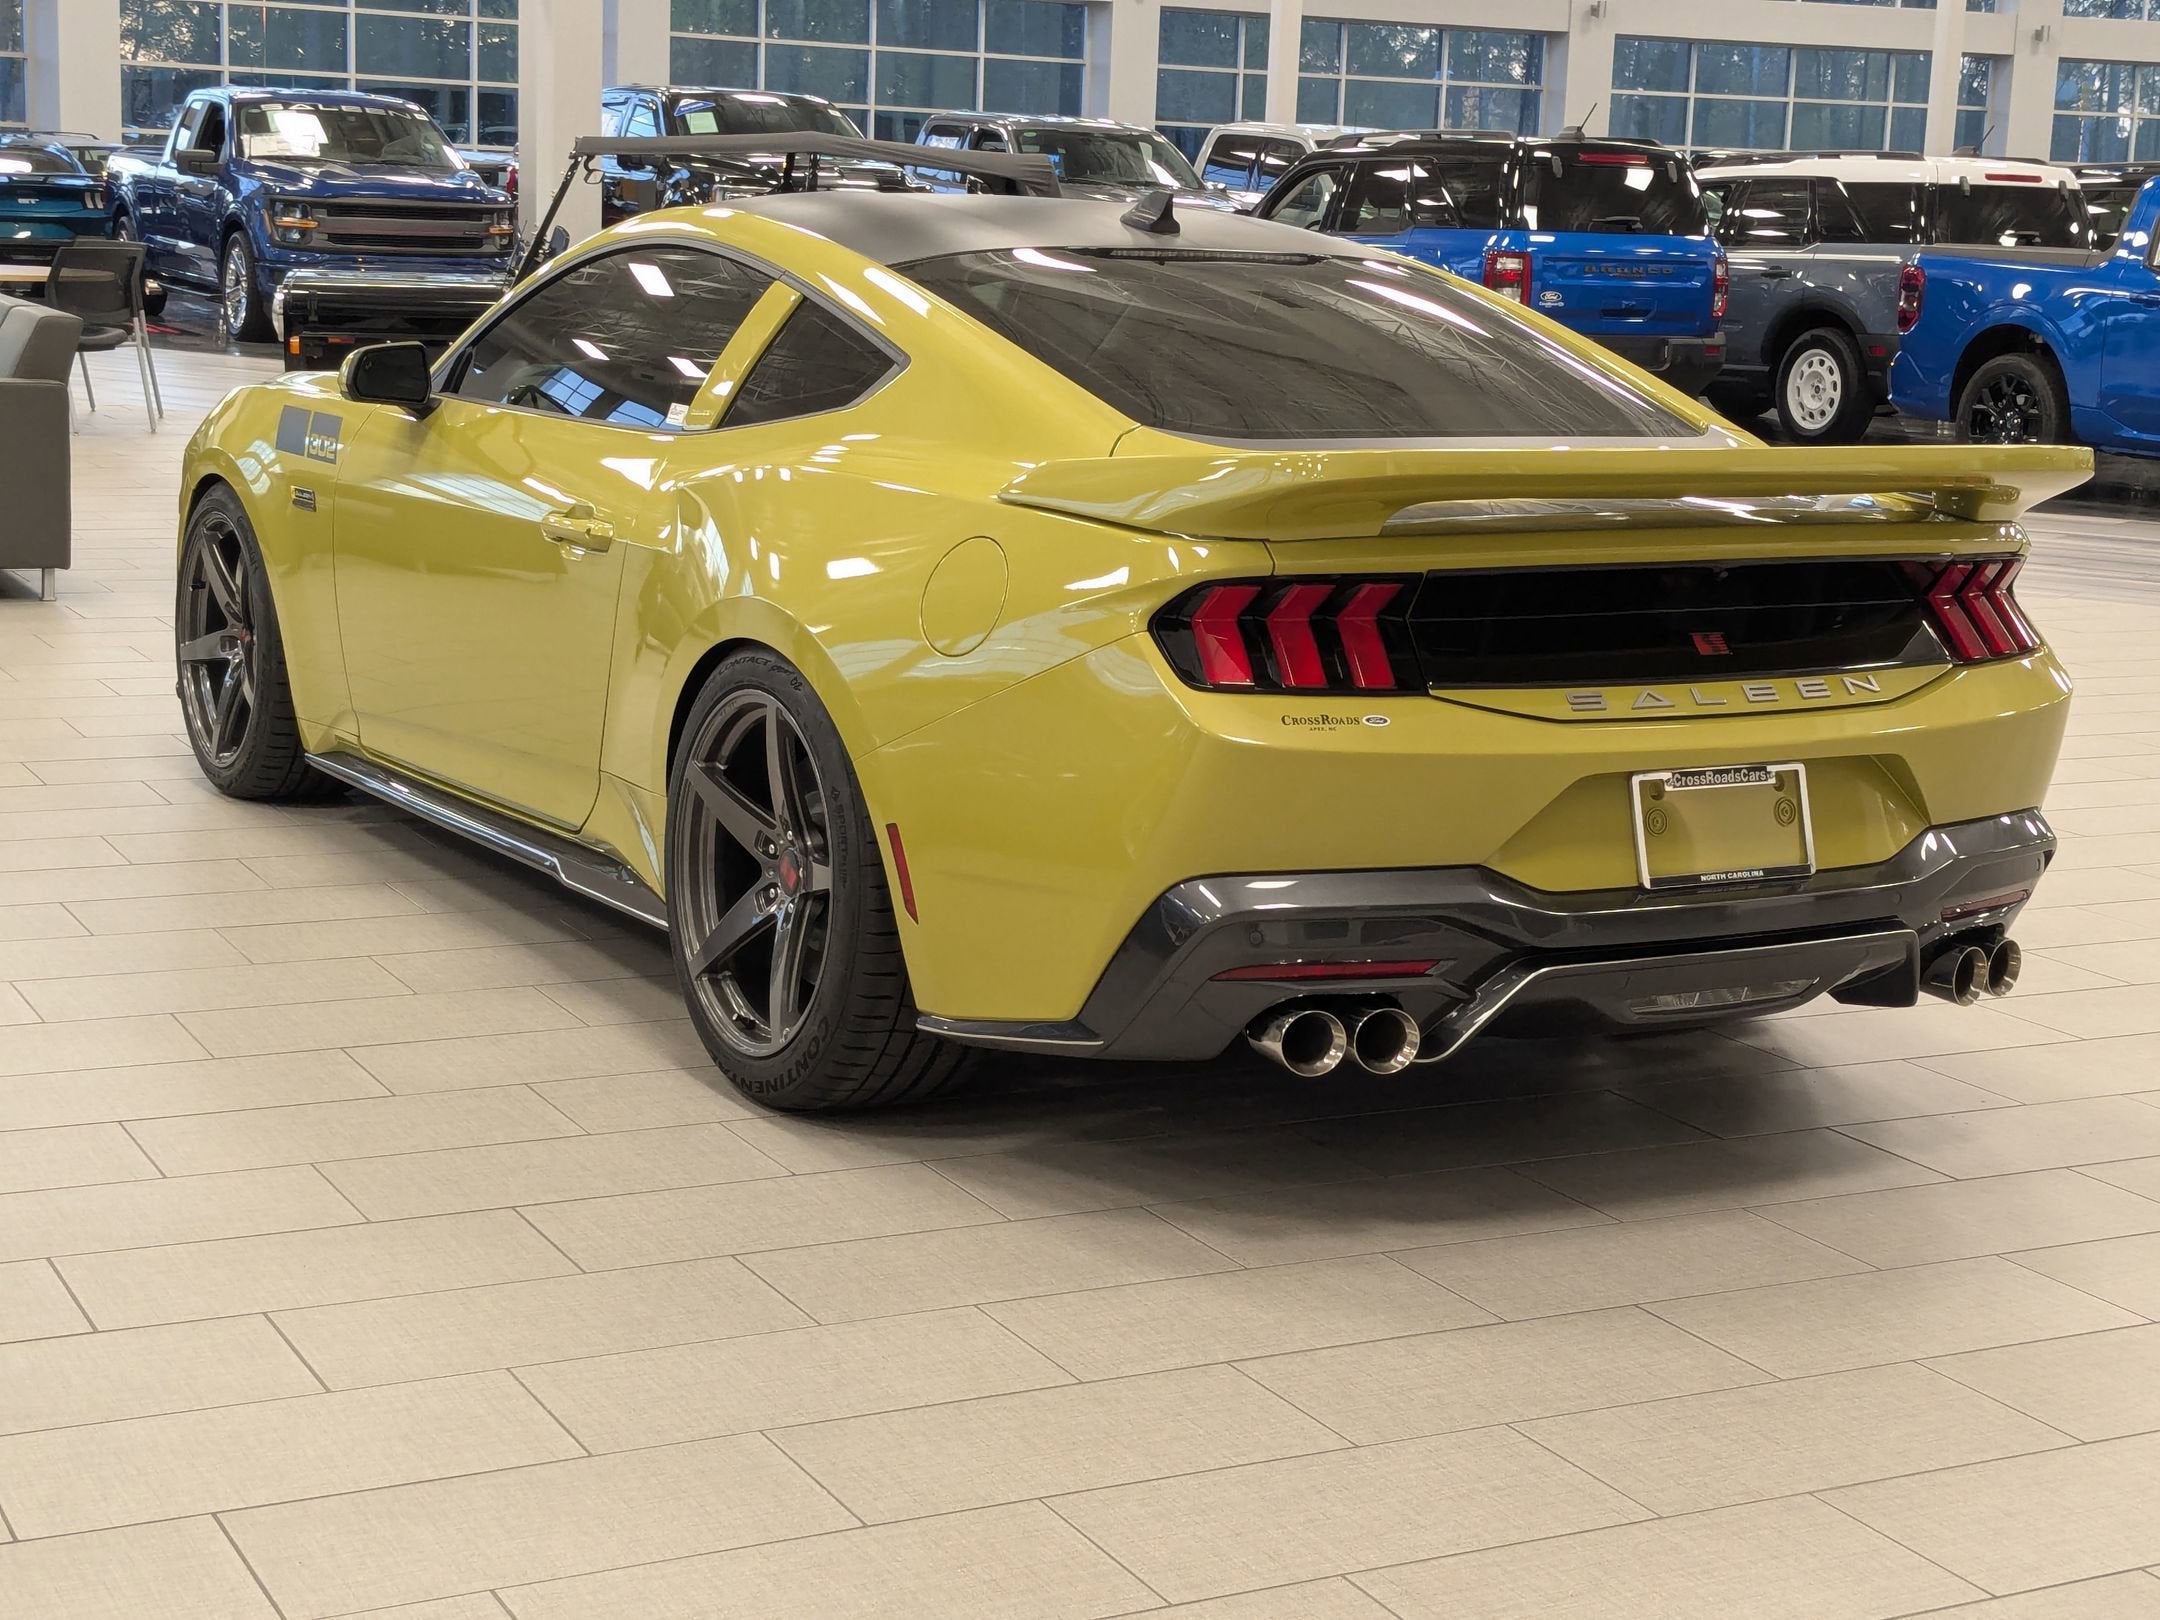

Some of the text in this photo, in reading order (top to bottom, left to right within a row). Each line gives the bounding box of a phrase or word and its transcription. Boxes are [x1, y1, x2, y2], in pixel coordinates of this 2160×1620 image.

[260, 103, 412, 120] SALEEN
[309, 433, 336, 459] 302
[1566, 673, 1881, 712] SALEEN
[1700, 870, 1765, 882] NORTH CAROLINA
